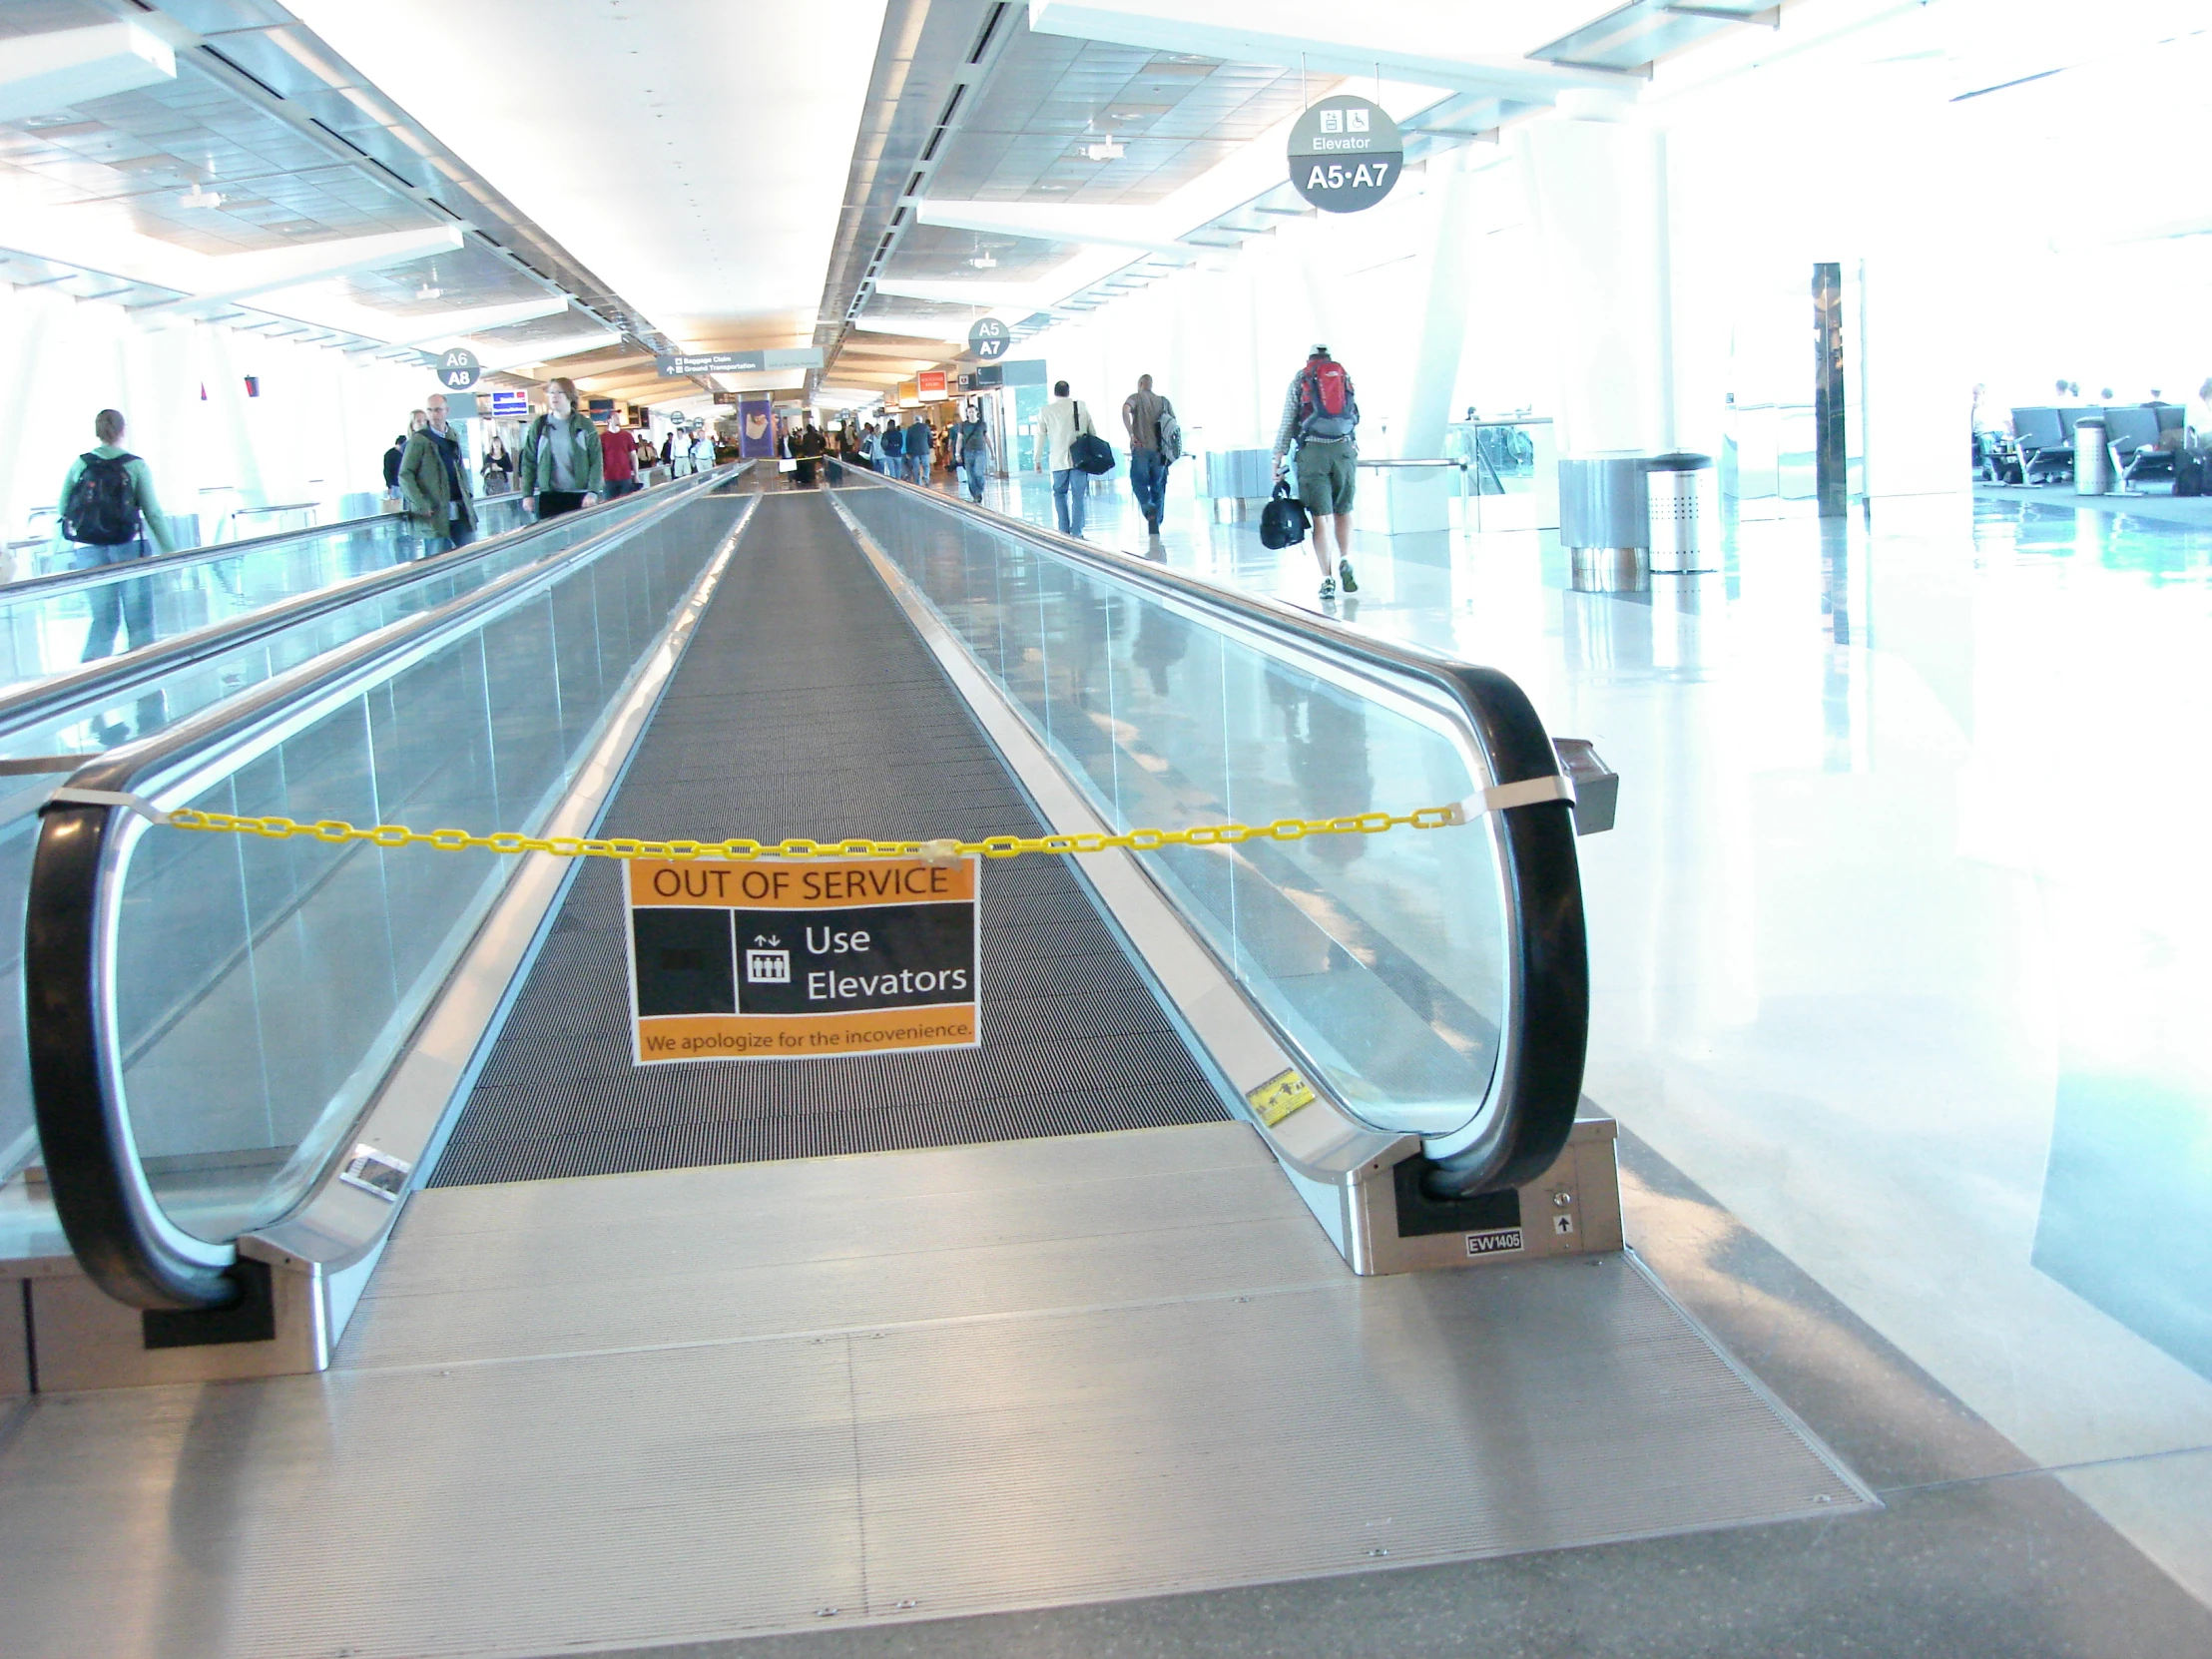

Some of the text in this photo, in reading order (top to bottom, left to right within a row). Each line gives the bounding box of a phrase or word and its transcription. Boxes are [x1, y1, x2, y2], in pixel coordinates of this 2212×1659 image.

[1313, 137, 1371, 151] Elevator
[979, 322, 999, 336] A5
[979, 340, 1000, 355] A7
[446, 352, 468, 366] A6
[710, 362, 756, 371] Transportation
[448, 370, 470, 386] A8
[653, 865, 949, 899] OUT OF SERVICE
[806, 925, 870, 955] Use
[808, 967, 967, 1000] Elevators
[646, 1023, 973, 1053] We apologize for the incovenience.
[1468, 1234, 1520, 1252] EW1405
